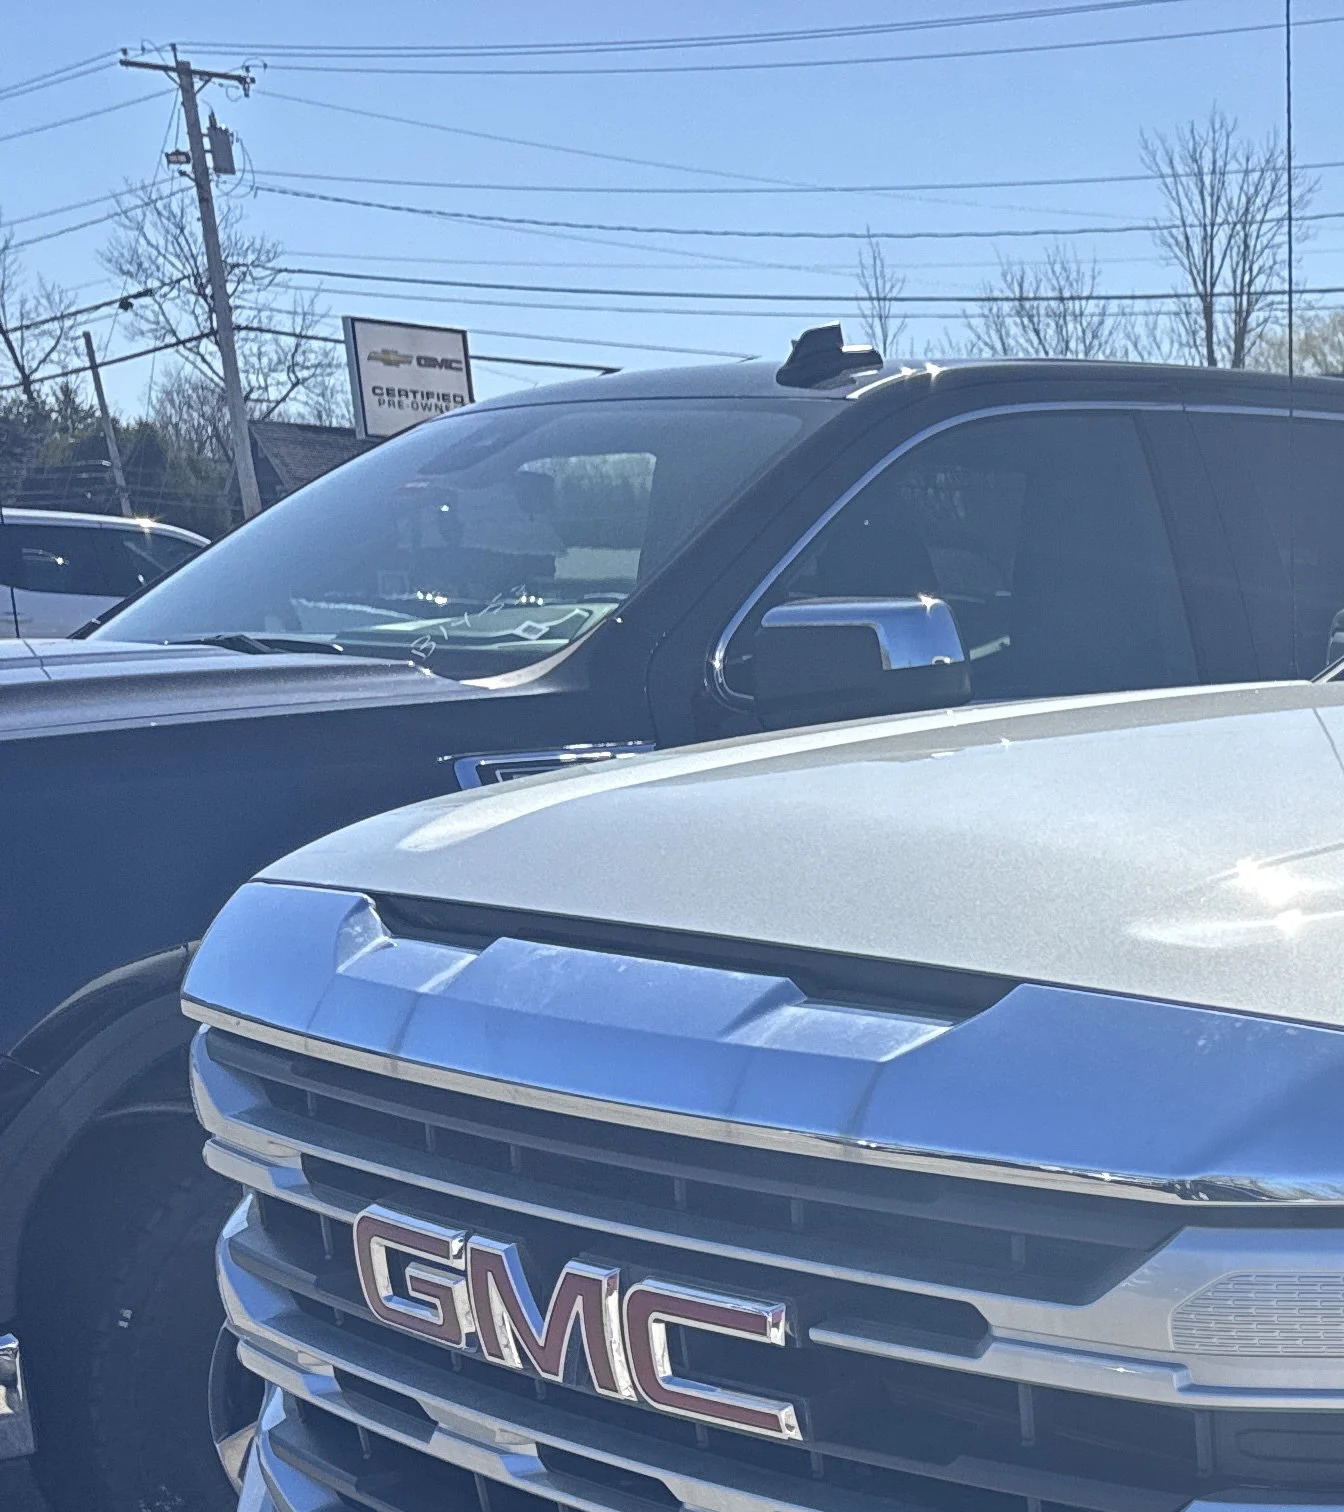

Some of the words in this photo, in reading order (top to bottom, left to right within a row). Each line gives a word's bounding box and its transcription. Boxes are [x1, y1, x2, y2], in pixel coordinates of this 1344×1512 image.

[416, 355, 463, 371] GMC
[371, 385, 464, 405] CERTIFIED
[353, 1203, 804, 1441] GMC
